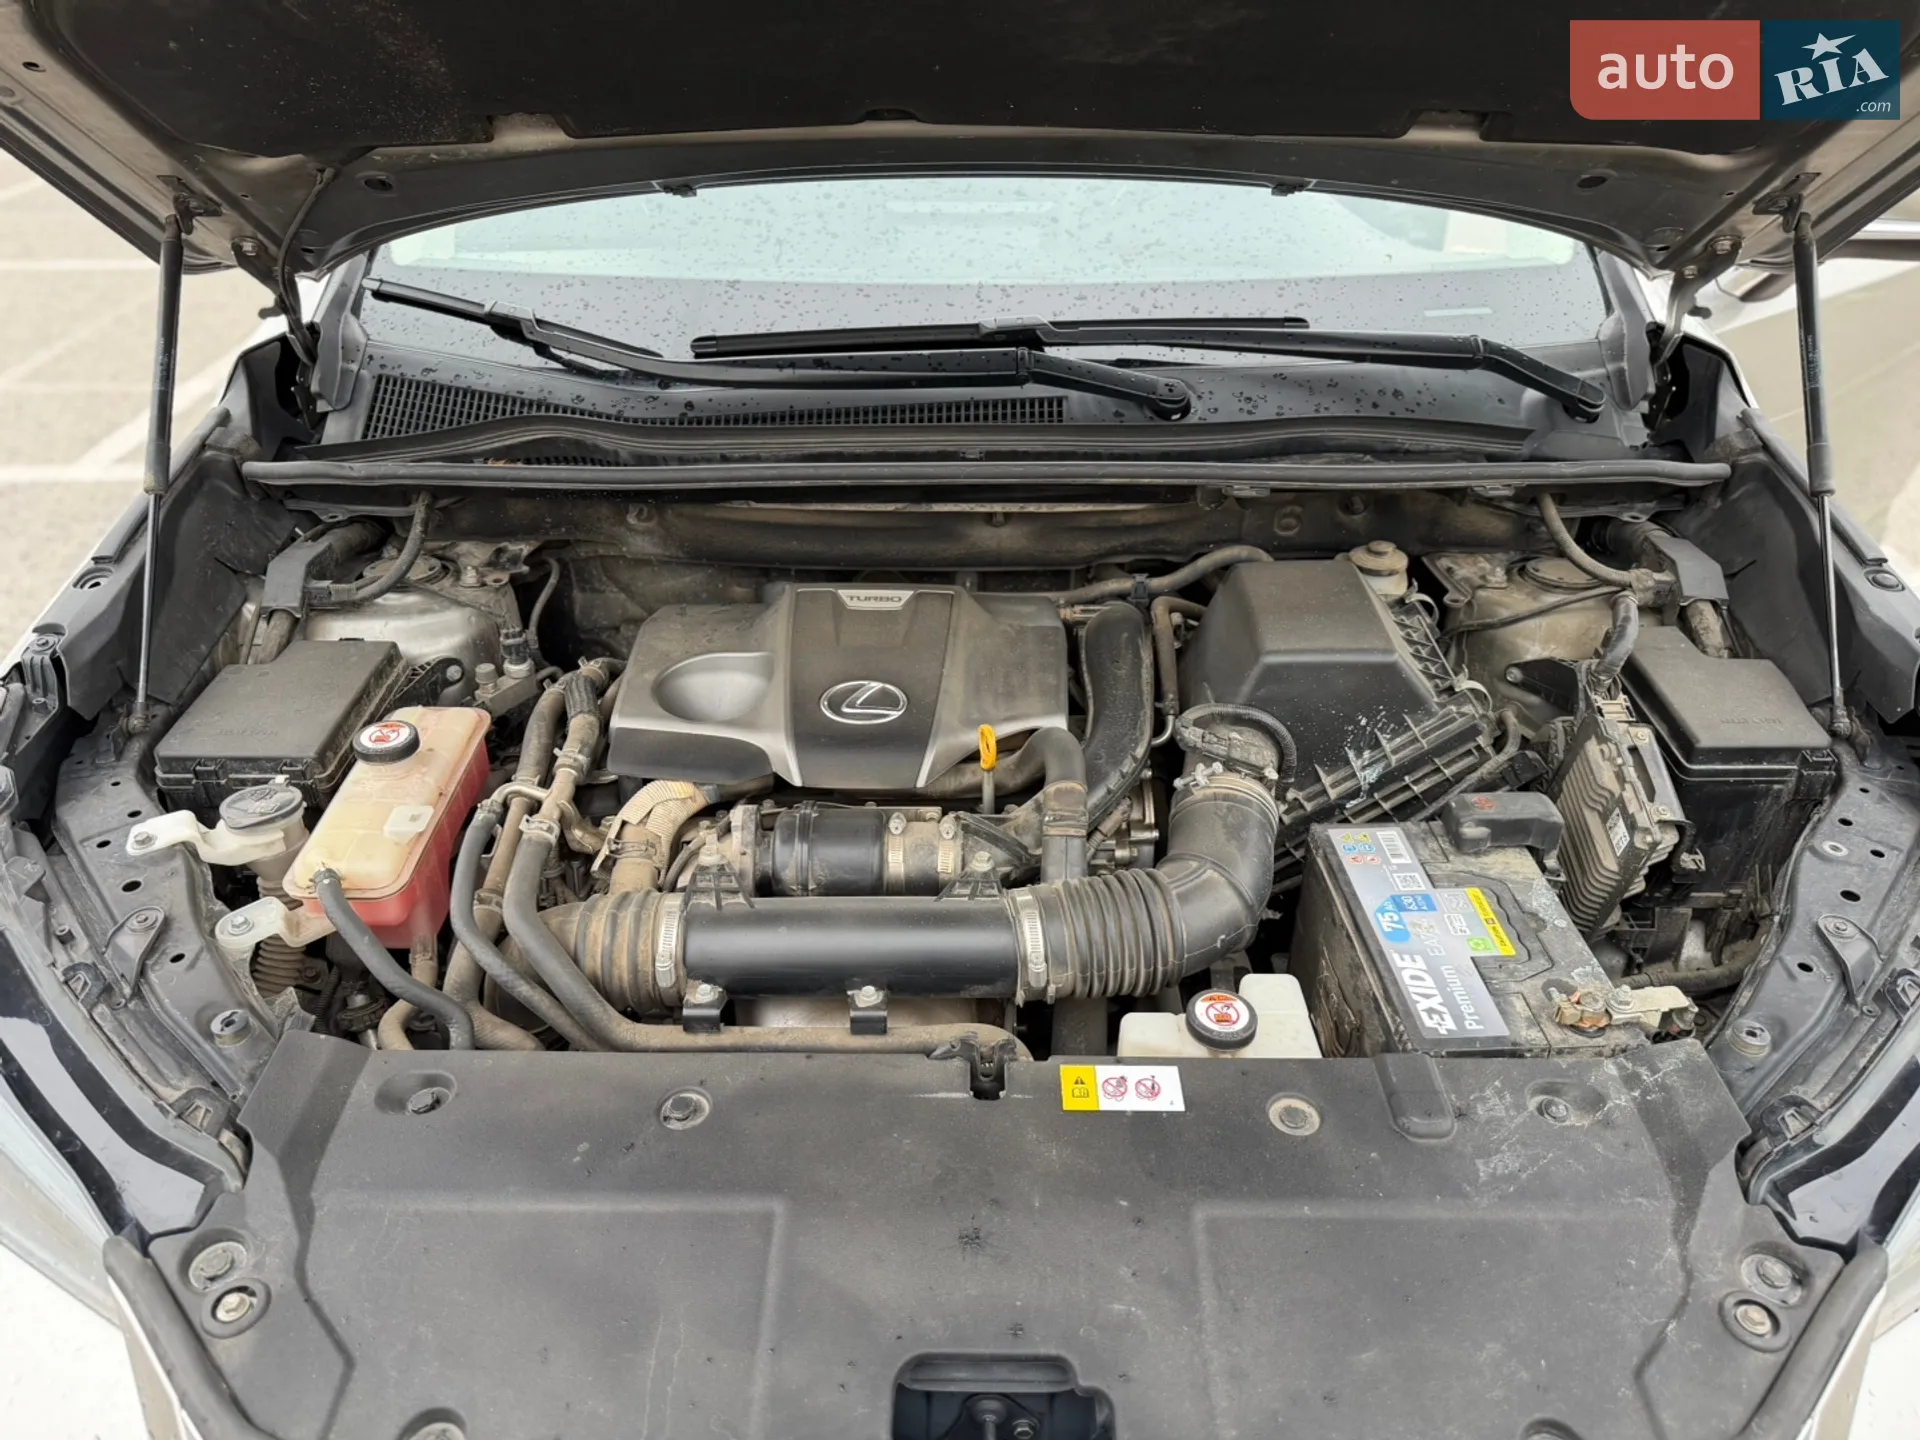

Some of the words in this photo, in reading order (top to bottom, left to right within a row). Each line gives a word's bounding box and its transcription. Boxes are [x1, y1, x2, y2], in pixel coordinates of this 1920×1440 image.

[848, 594, 903, 603] TURBO
[1376, 911, 1405, 932] 75
[1391, 951, 1459, 1035] EXIDE
[1440, 964, 1485, 1030] Premium
